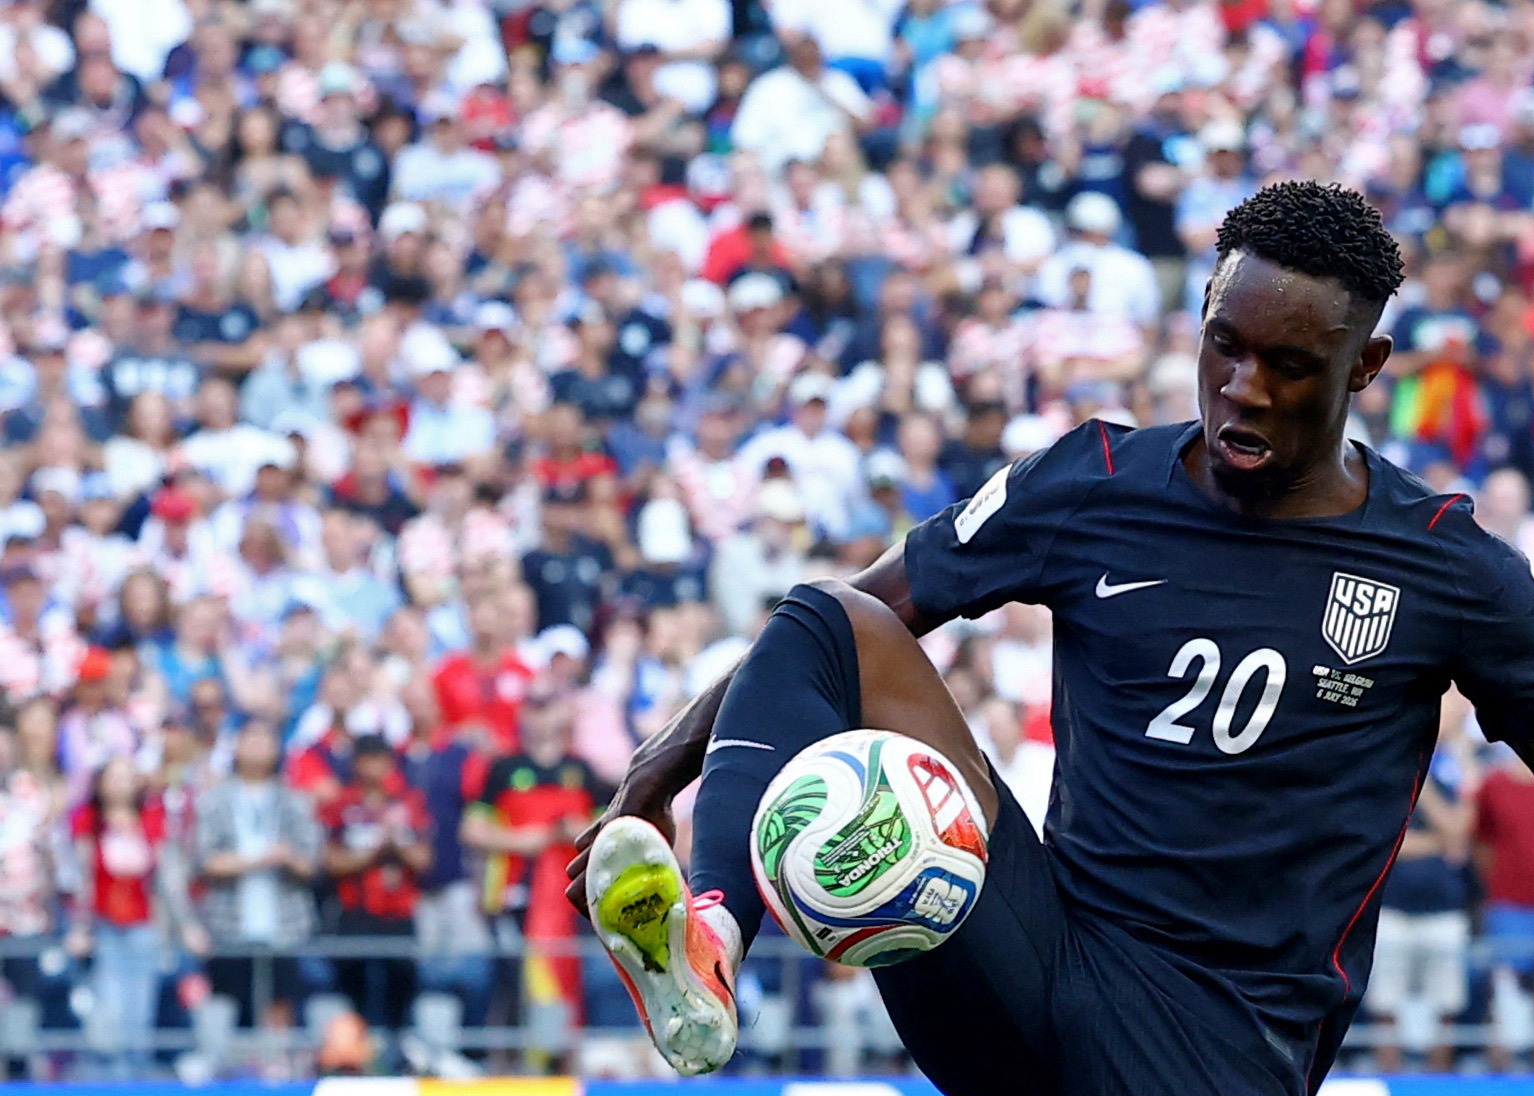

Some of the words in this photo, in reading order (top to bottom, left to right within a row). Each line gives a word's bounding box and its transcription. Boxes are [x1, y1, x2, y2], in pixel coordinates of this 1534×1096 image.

[1335, 578, 1394, 616] USA
[1145, 637, 1287, 755] 20
[838, 837, 904, 887] TRIONDA
